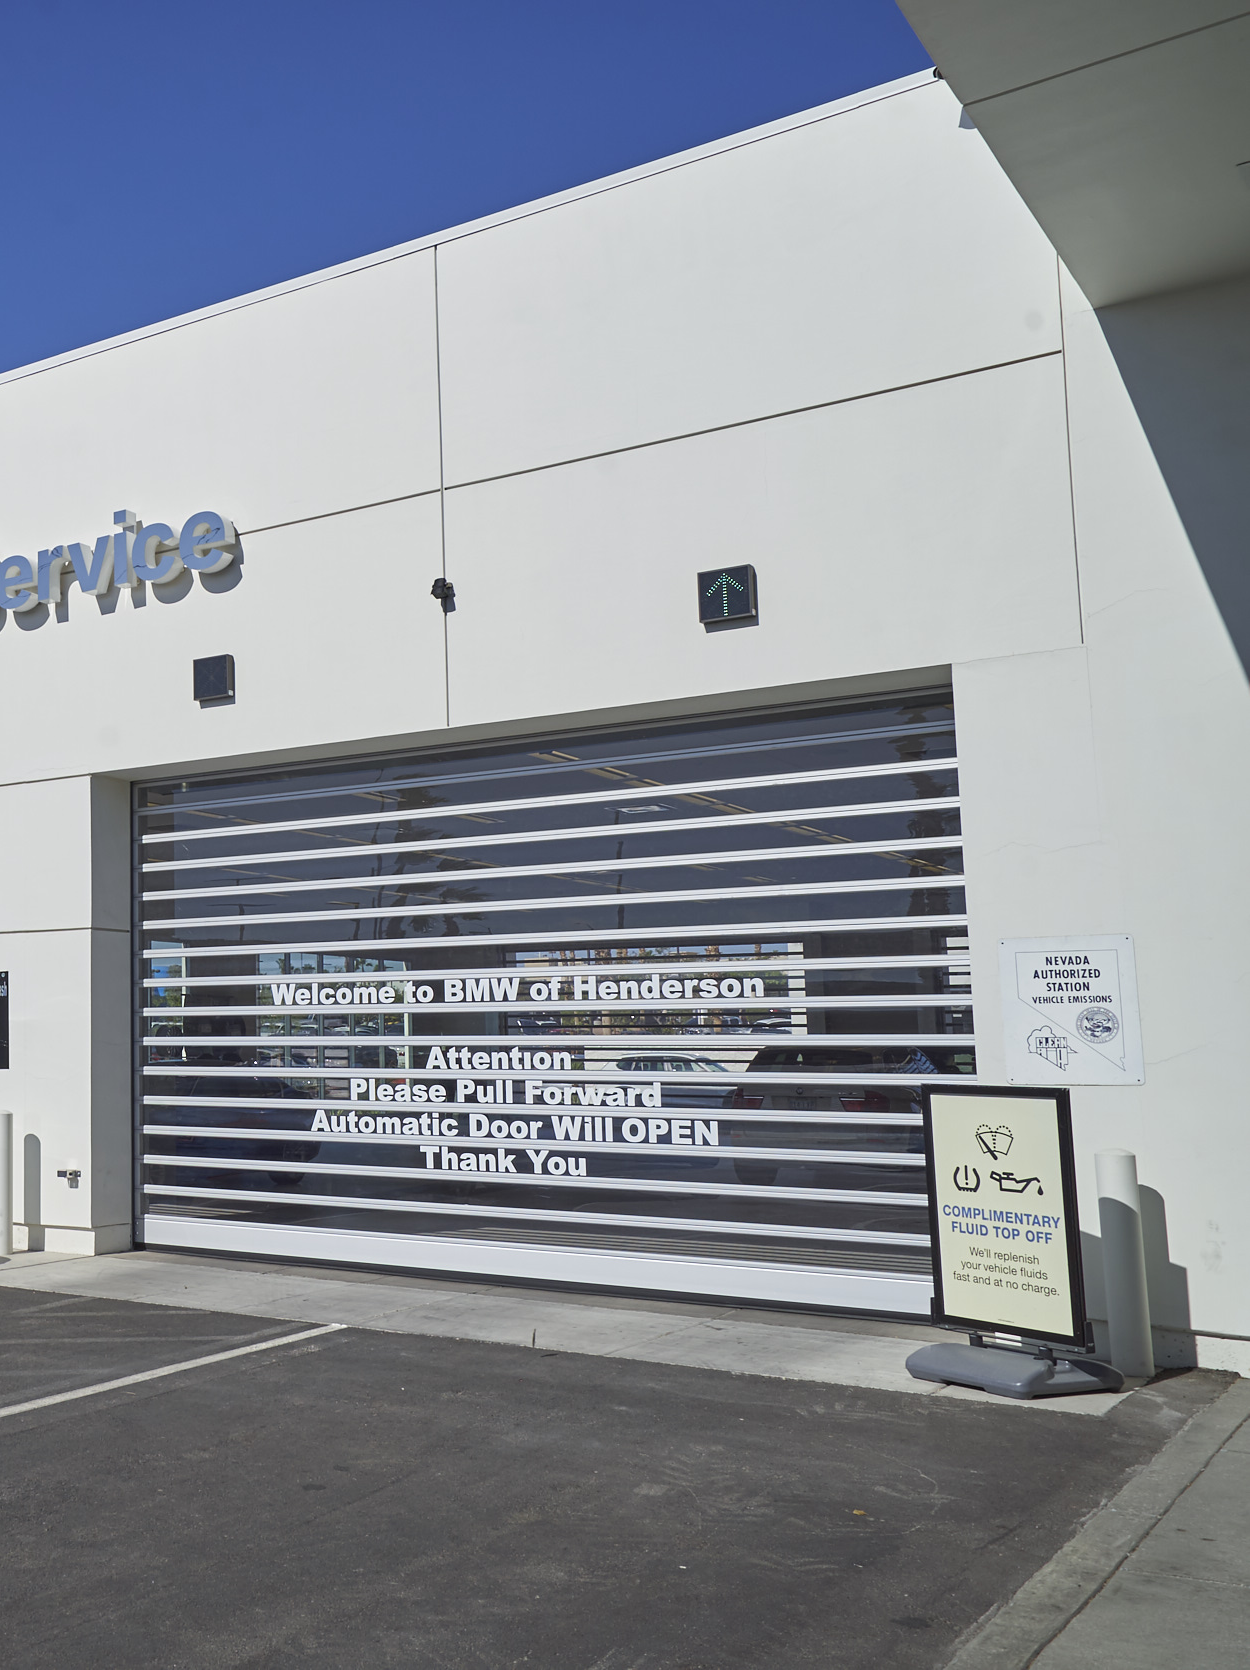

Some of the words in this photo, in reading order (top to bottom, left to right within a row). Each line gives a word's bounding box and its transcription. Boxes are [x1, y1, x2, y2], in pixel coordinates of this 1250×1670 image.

[1045, 956, 1090, 966] NEVADA
[1033, 968, 1101, 979] AUTHORIZED
[271, 982, 396, 1005] Welcome
[405, 980, 434, 1003] to
[444, 977, 520, 1003] BMW
[530, 976, 561, 1001] of
[574, 974, 765, 1000] Henderson
[1046, 982, 1090, 992] STATION
[1032, 996, 1065, 1004] VEHICLE
[1068, 995, 1113, 1004] EMISSIONS
[426, 1046, 572, 1071] Attention
[350, 1078, 447, 1103] Please
[457, 1079, 514, 1104] Pull
[525, 1080, 662, 1108] Forward
[311, 1109, 459, 1137] Automatic
[469, 1113, 543, 1140] Door
[551, 1115, 614, 1143] Will
[621, 1117, 719, 1146] OPEN
[419, 1145, 518, 1173] Thank
[526, 1148, 588, 1177] You
[942, 1204, 1061, 1229] COMPLIMENTARY
[951, 1221, 989, 1237] FLUID
[993, 1225, 1021, 1241] TOP
[1025, 1230, 1053, 1244] OFF
[969, 1246, 991, 1259] We'll
[993, 1250, 1040, 1266] replenish
[960, 1260, 982, 1272] your
[983, 1262, 1018, 1277] vehicle
[1020, 1267, 1049, 1281] fluids
[953, 1271, 971, 1283] fast
[972, 1273, 992, 1286] and
[993, 1278, 1004, 1288] at
[1005, 1280, 1019, 1290] no
[1021, 1281, 1061, 1297] charge.
